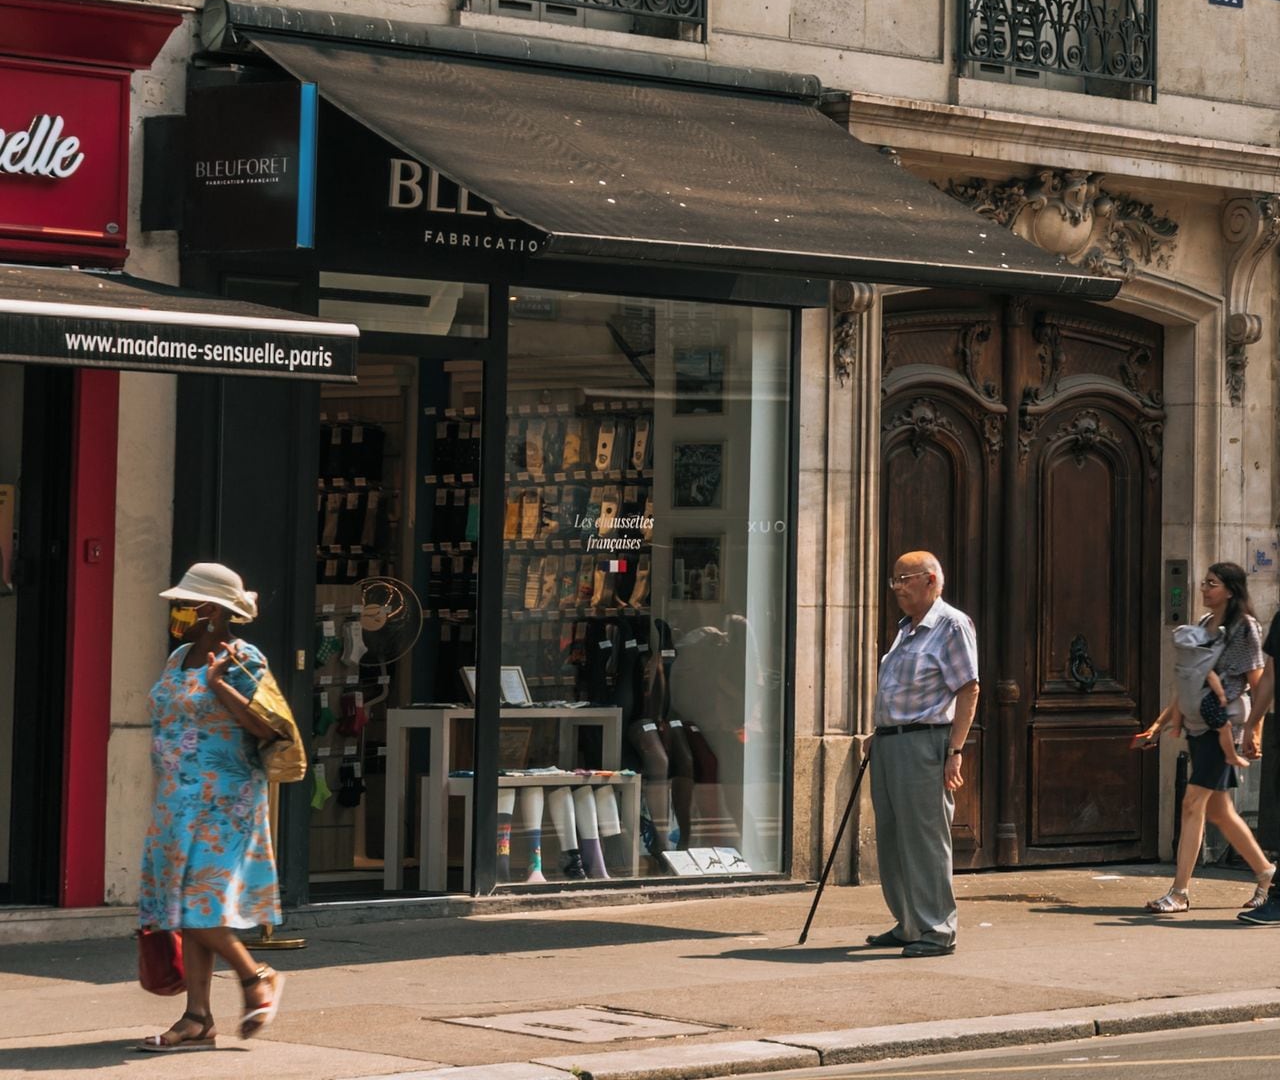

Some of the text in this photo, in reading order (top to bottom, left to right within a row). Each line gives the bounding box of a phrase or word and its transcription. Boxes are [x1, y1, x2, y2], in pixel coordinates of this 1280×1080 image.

[424, 230, 546, 252] FABRICATIO
[65, 332, 333, 371] www.madame-sensuelle.paris
[574, 514, 655, 531] Les chaussettes
[586, 534, 642, 553] françaises
